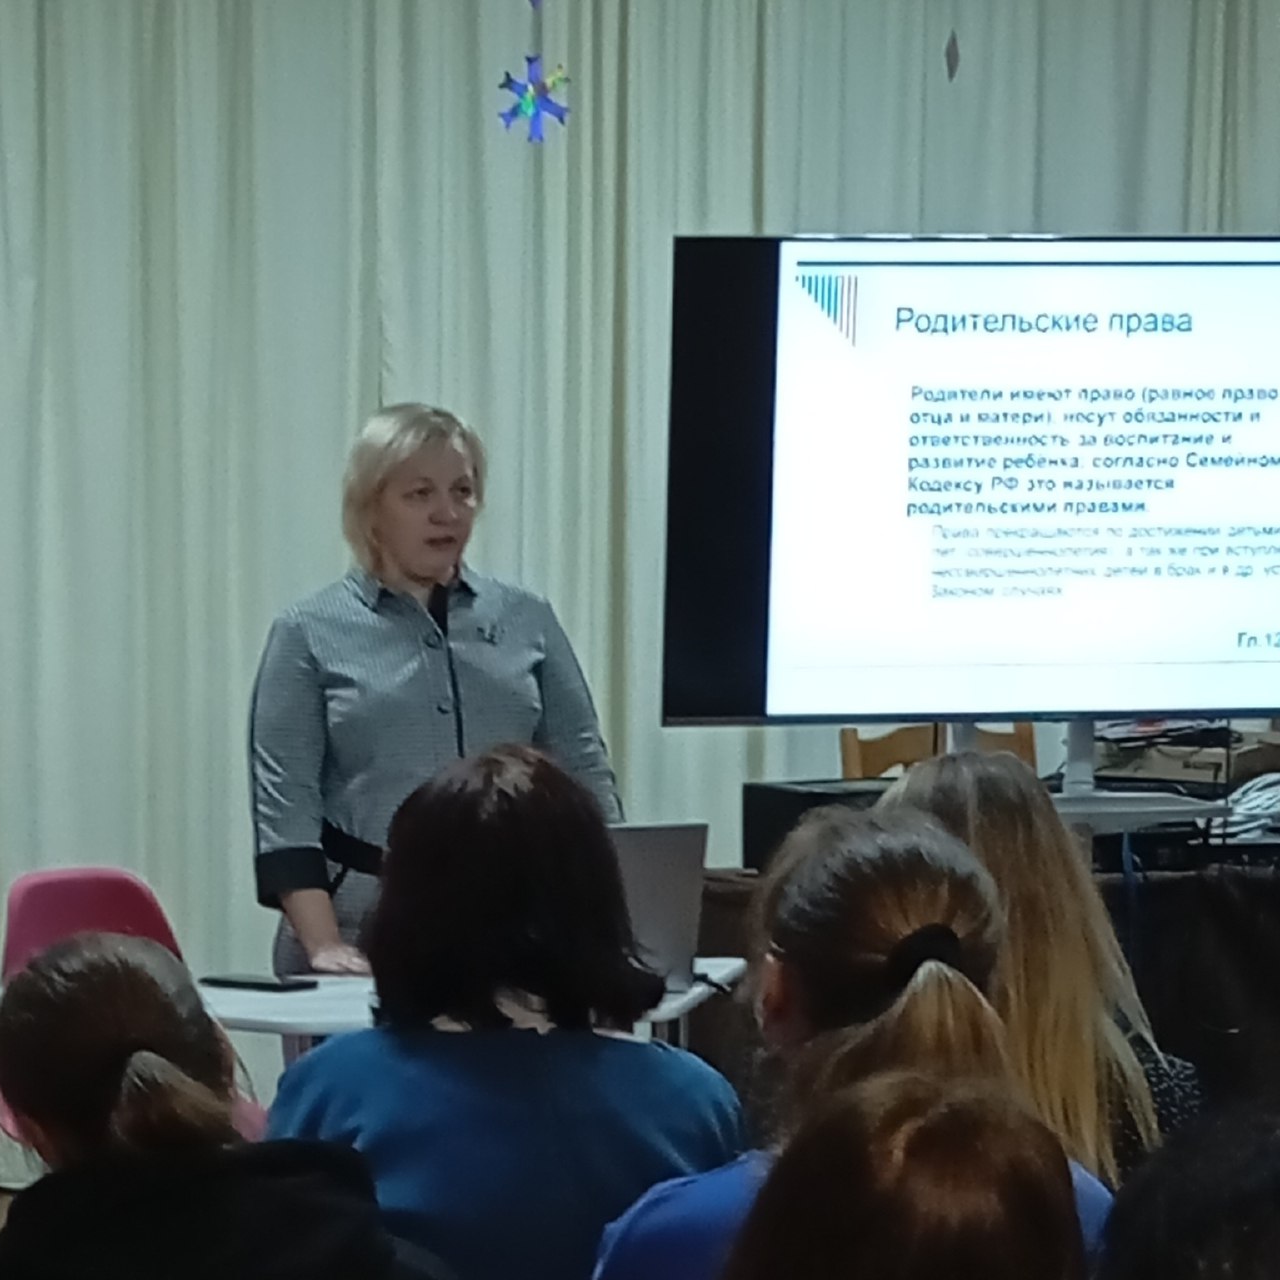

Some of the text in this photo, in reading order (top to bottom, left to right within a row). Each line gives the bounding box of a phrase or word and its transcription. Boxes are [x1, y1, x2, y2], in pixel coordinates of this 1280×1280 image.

[895, 306, 1193, 338] Родительские права
[911, 385, 1279, 404] Родители имеют право (равное право
[909, 411, 953, 426] отца
[959, 411, 971, 424] и
[1122, 407, 1244, 424] обязанности
[1249, 411, 1261, 423] и
[908, 432, 1233, 447] ответственность за воспитание и
[907, 456, 998, 472] развитие
[1092, 455, 1180, 469] согласно
[907, 475, 1176, 495] Кодексу РФ это называется
[906, 501, 1058, 518] родительскими
